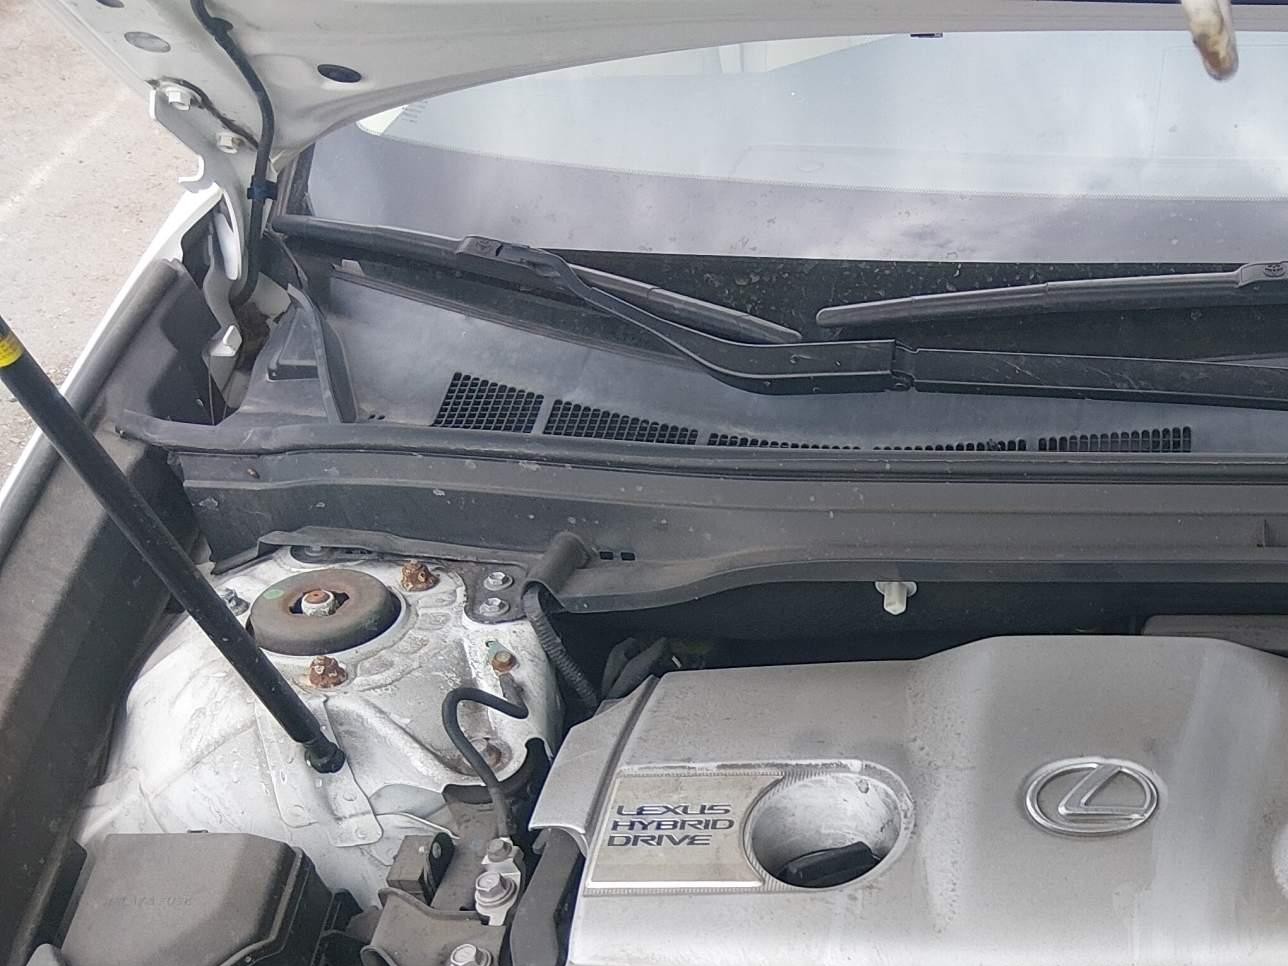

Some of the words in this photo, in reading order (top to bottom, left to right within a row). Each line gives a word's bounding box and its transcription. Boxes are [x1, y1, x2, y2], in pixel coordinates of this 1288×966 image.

[616, 804, 732, 816] LEXUS
[610, 818, 735, 831] HYBRID
[607, 834, 713, 847] DRIVE
